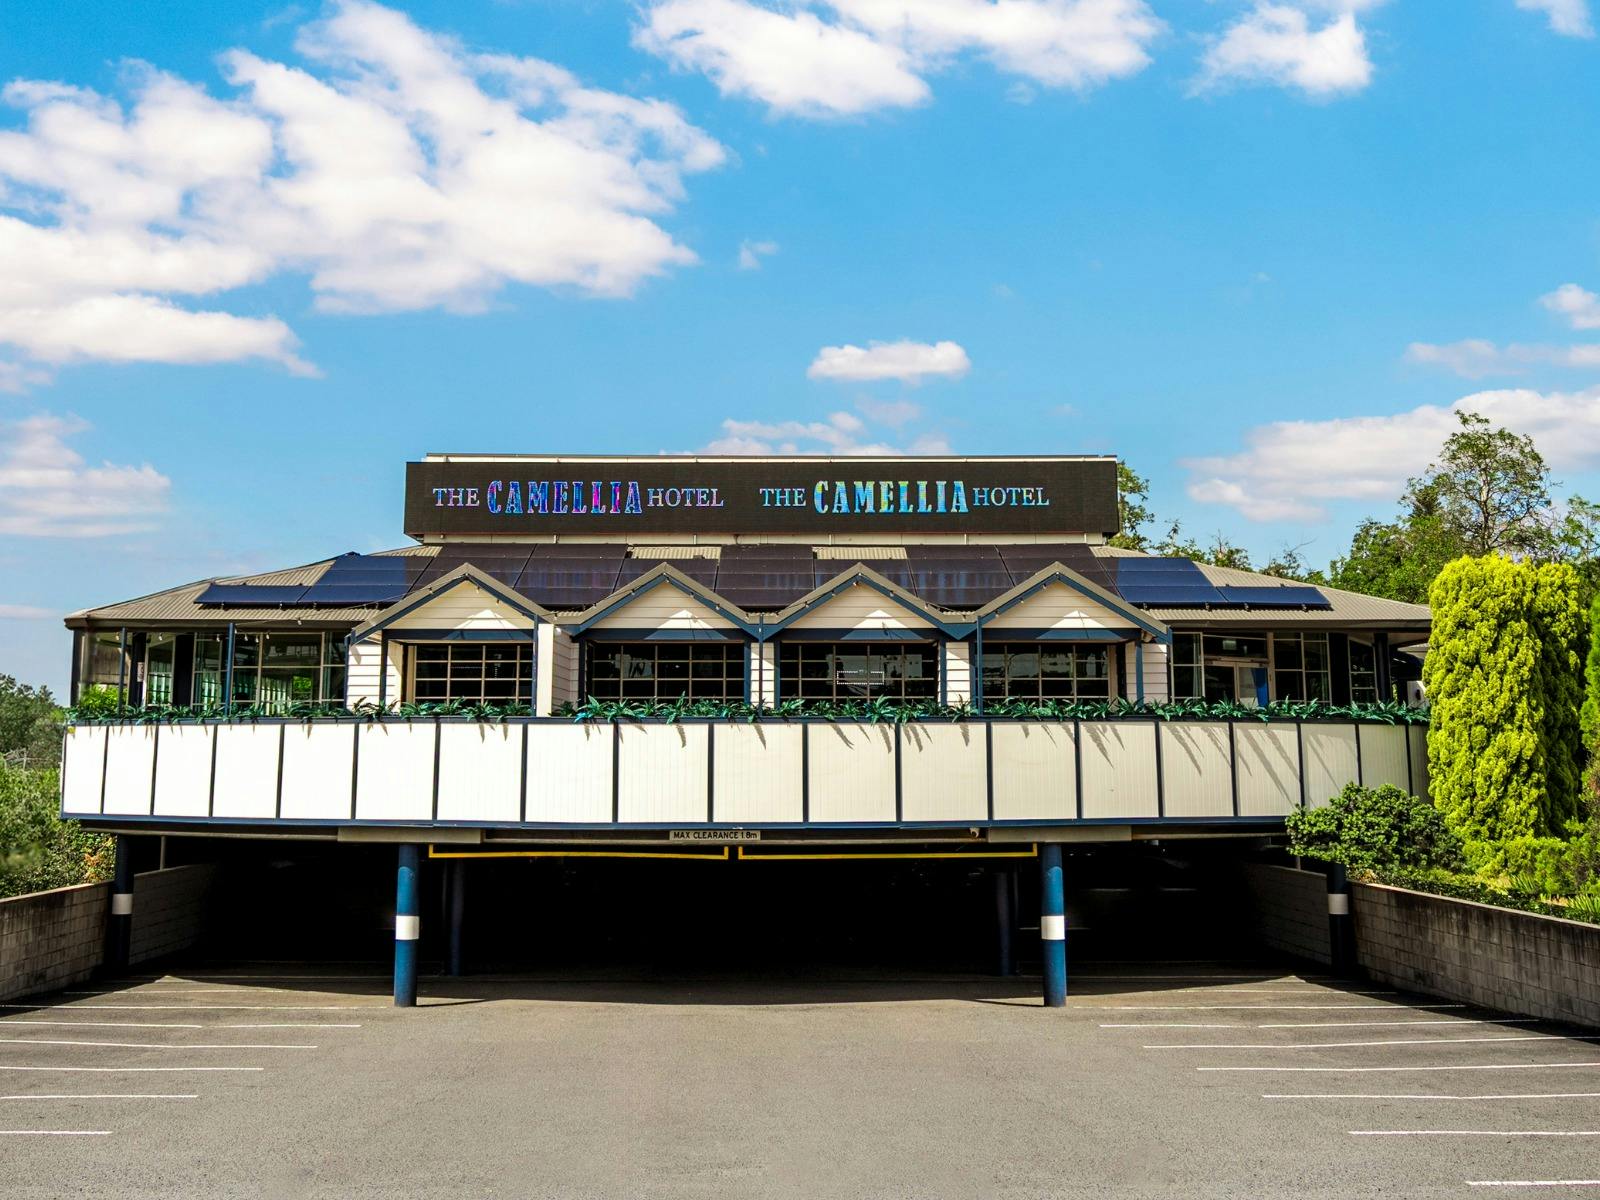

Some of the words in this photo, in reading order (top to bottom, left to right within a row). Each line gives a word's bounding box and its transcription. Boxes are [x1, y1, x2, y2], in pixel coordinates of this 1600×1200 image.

[433, 488, 480, 507] THE
[487, 480, 643, 514] CAMELLIA
[647, 488, 725, 507] HOTEL
[759, 488, 806, 507] THE
[813, 480, 968, 514] CAMELLIA
[972, 487, 1050, 507] HOTEL
[674, 831, 690, 839] MAX
[693, 831, 738, 839] CLEARANCE
[741, 831, 757, 840] 1.8m
